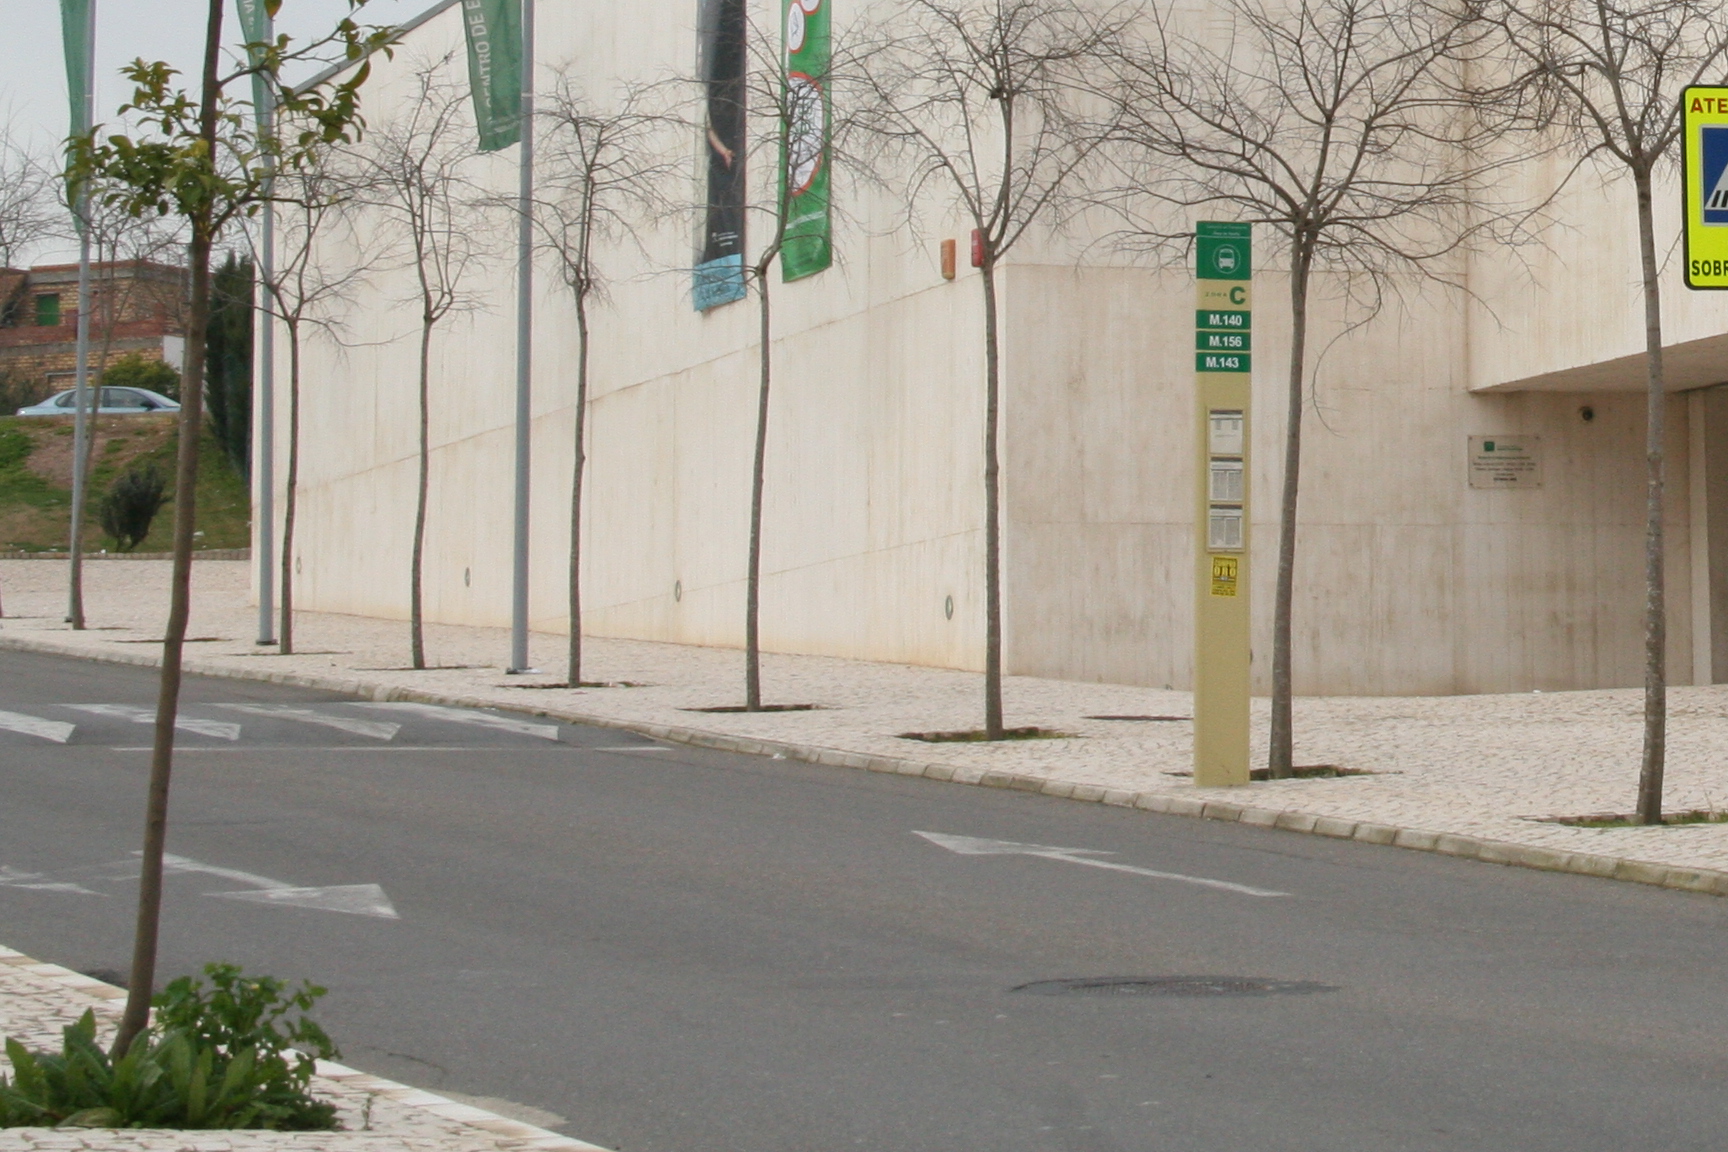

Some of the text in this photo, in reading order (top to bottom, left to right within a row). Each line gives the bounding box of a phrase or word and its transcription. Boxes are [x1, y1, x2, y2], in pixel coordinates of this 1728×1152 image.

[468, 12, 487, 37] DE
[1229, 286, 1247, 305] C
[1209, 314, 1242, 326] M.140
[1209, 336, 1242, 348] M.156
[1206, 356, 1239, 368] M.143
